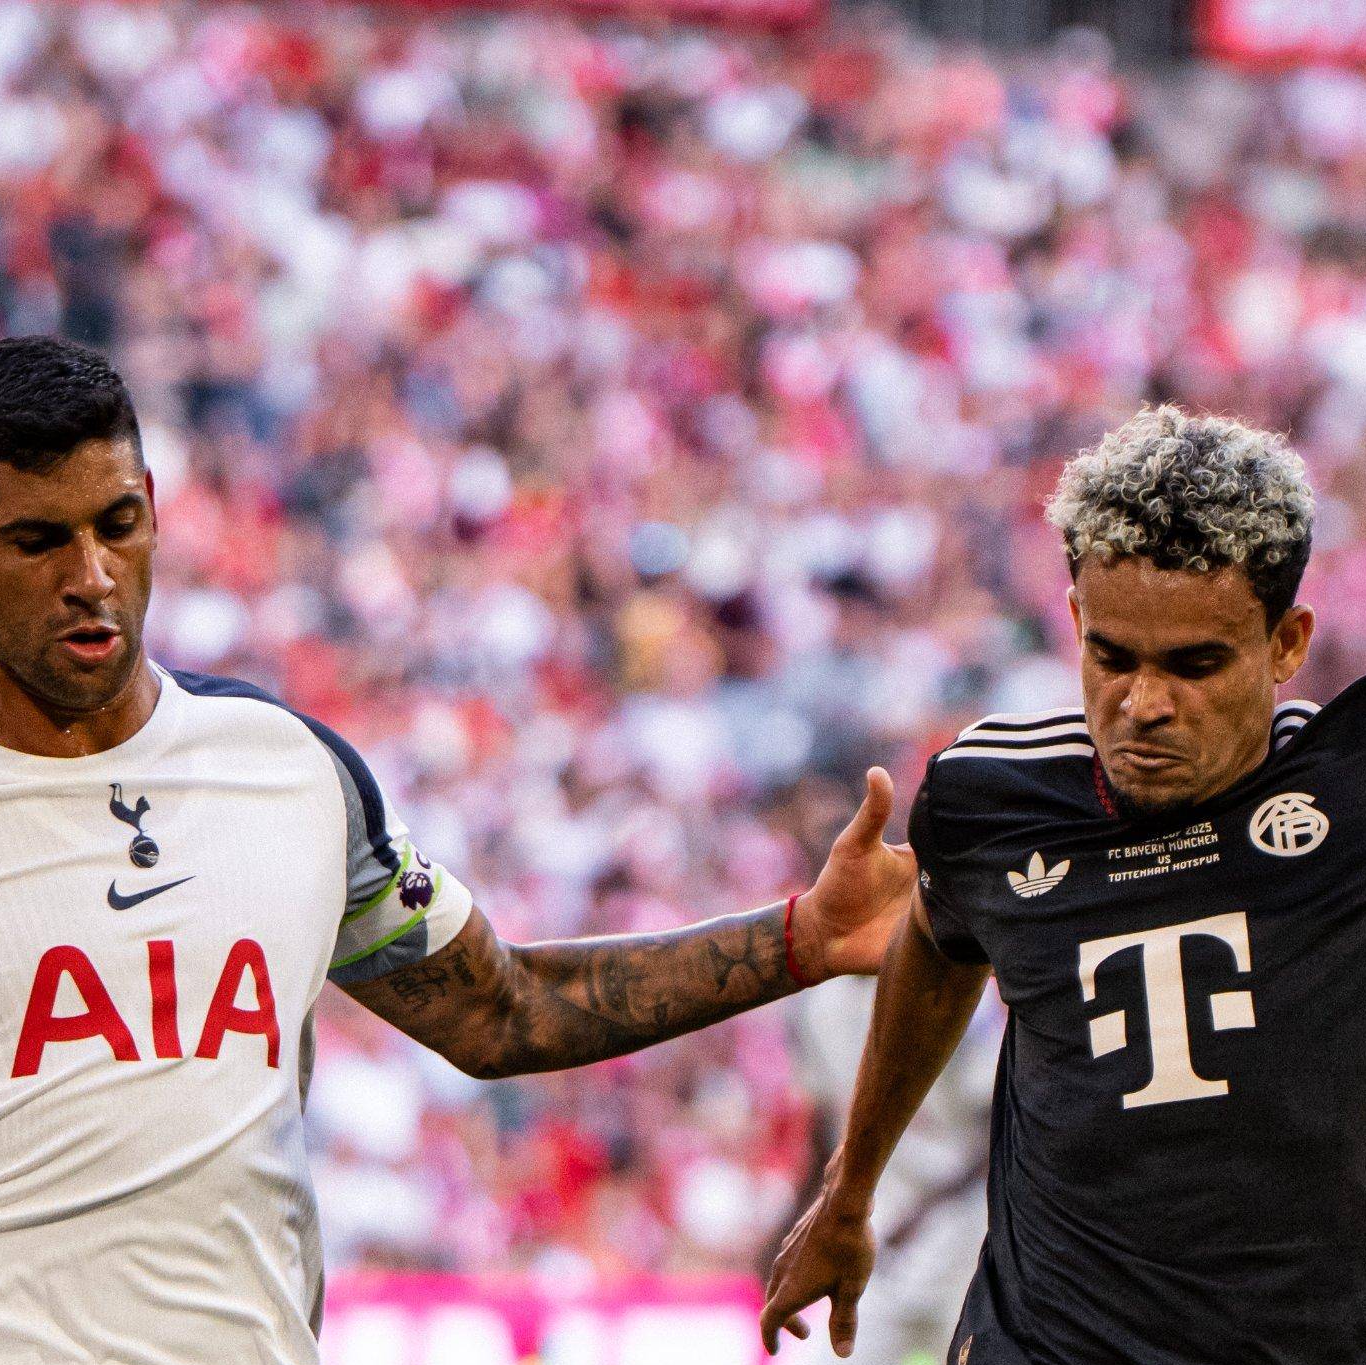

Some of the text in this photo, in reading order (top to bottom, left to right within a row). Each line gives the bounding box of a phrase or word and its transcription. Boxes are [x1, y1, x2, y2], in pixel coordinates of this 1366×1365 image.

[1185, 822, 1213, 836] 2025
[1108, 849, 1122, 860] FC
[1124, 843, 1166, 858] BAYERN
[1108, 853, 1221, 882] TOTTENHAM HOTSPUR
[11, 938, 280, 1078] AIA
[1078, 911, 1256, 1109] T
